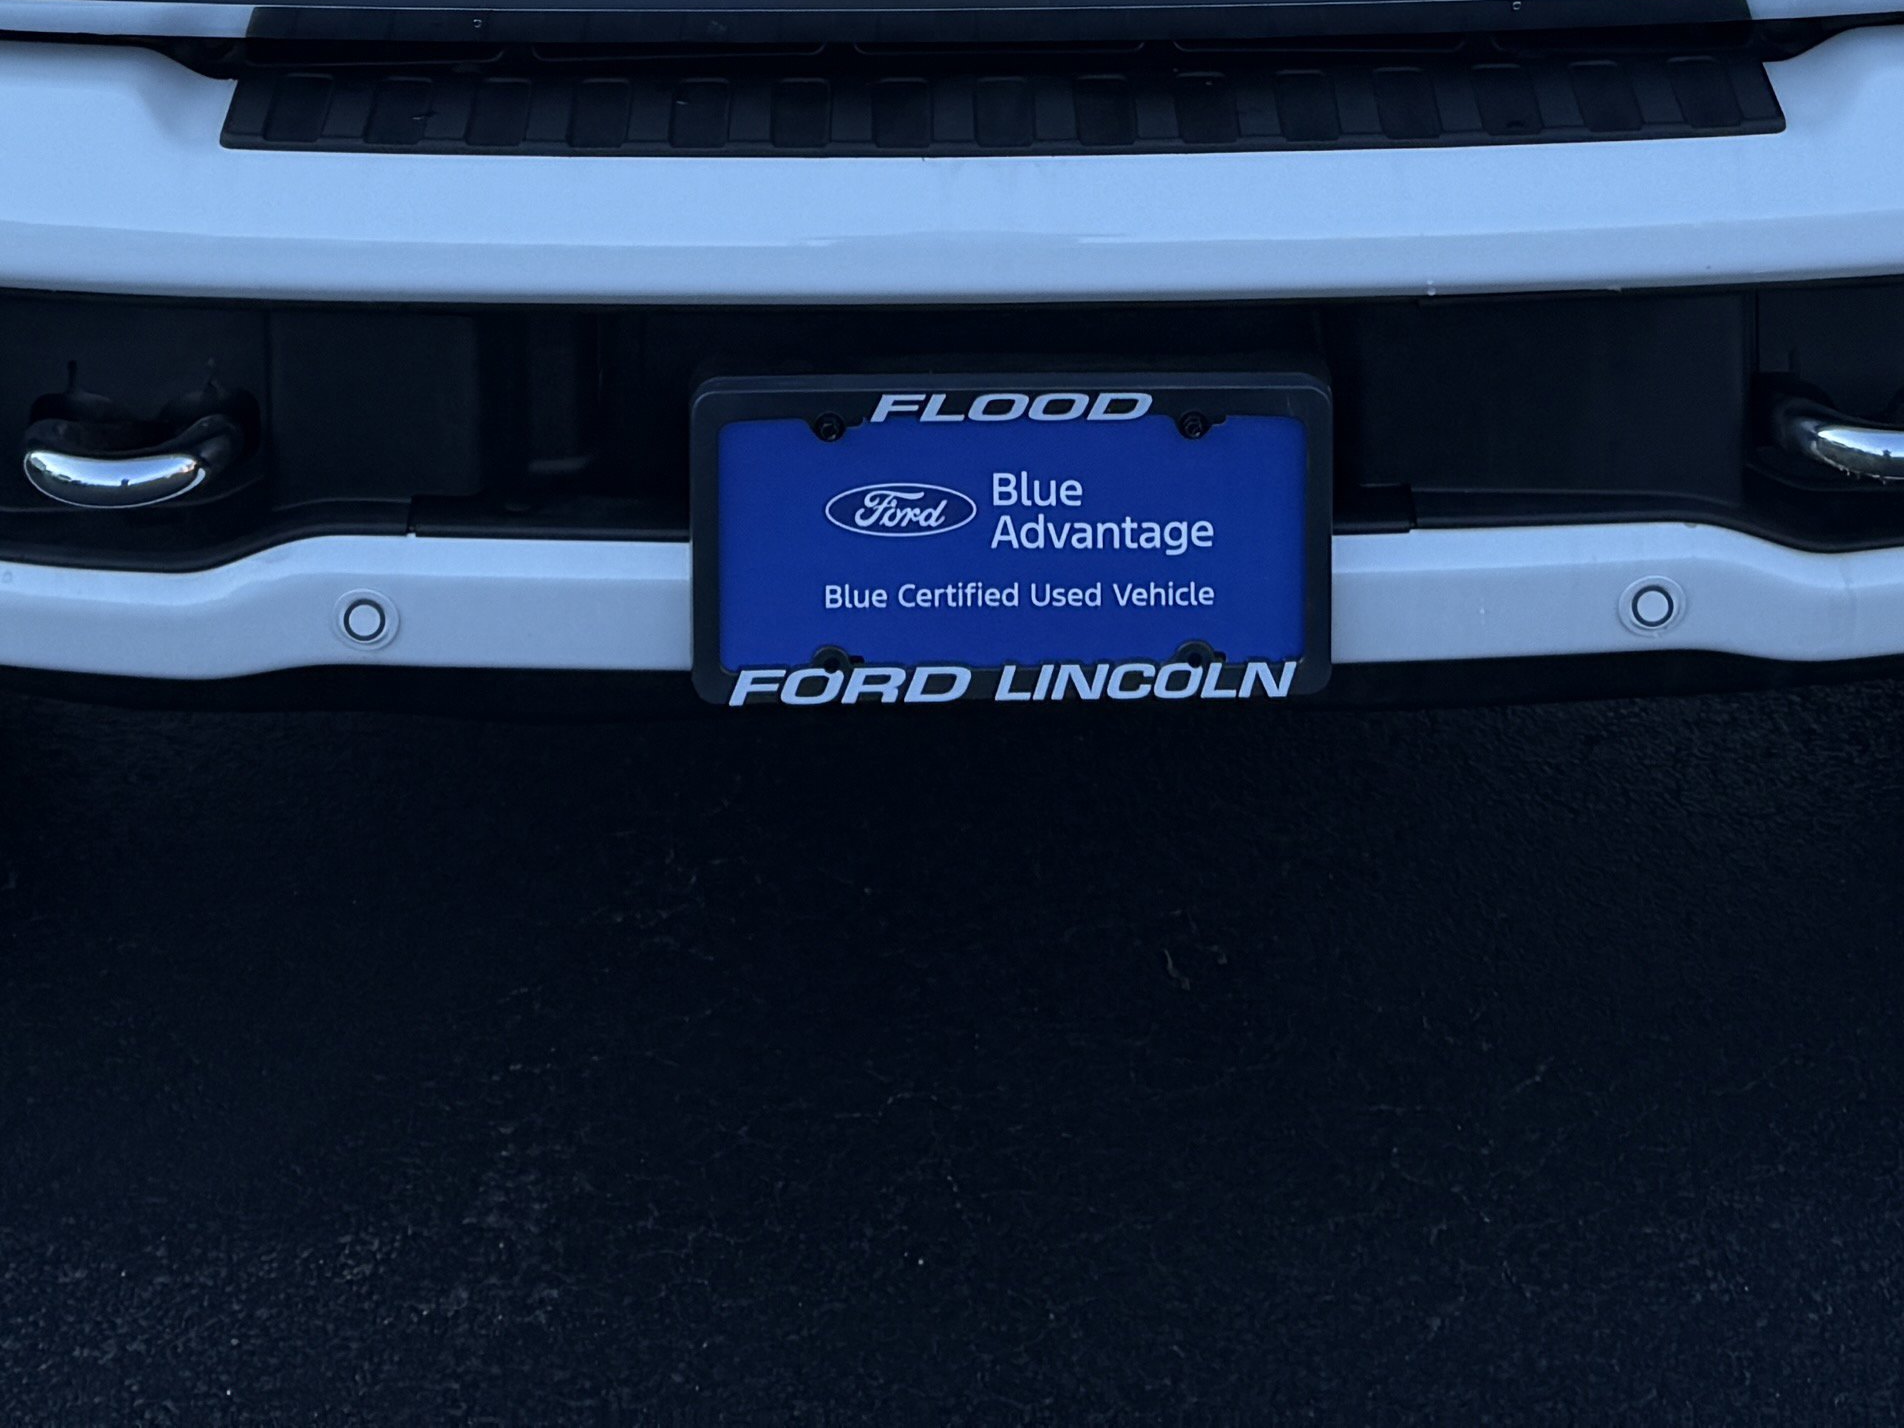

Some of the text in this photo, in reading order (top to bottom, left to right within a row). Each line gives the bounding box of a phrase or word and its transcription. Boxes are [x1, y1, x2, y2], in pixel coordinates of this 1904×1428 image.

[869, 392, 1153, 422] FLOOD
[992, 470, 1083, 507] Blue
[853, 489, 947, 530] Ford
[991, 514, 1214, 556] Advantage
[825, 581, 1215, 609] Blue Certified Used Vehicle
[728, 661, 1297, 706] FORD LINCOLN
